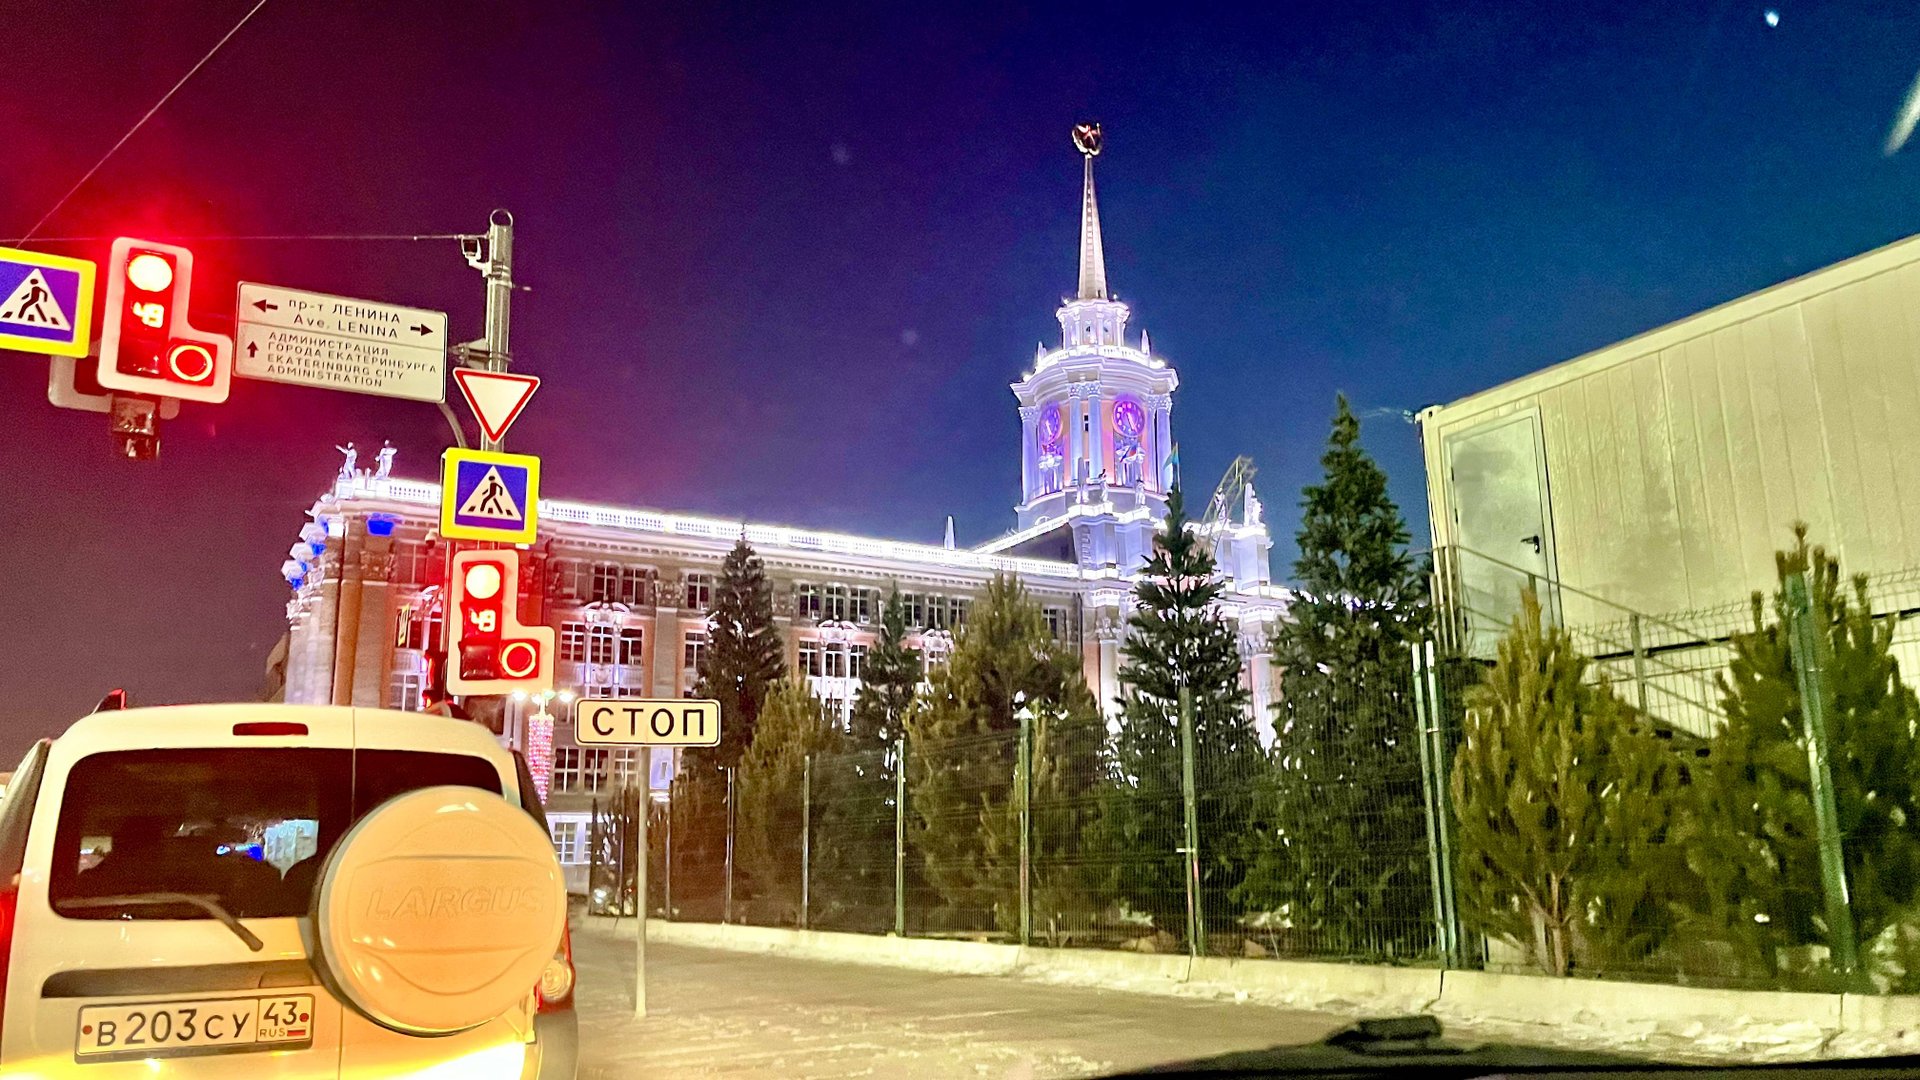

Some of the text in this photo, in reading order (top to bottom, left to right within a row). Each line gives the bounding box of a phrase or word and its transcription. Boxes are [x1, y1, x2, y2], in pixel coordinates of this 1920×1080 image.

[289, 299, 401, 324] пр-т ЛЕНИНА
[338, 319, 398, 339] LENINA
[269, 331, 389, 356] АДМИНИСТРАЦИЯ
[267, 353, 404, 380] EKATERINBURG CITY
[268, 341, 436, 373] ГОРОДА ЕКАТЕРИНБУРГА
[267, 364, 382, 387] ADMINISTRATION
[592, 707, 704, 737] СТОП
[366, 886, 544, 920] LARGUS
[263, 1001, 298, 1026] 43
[259, 1027, 286, 1038] RUS
